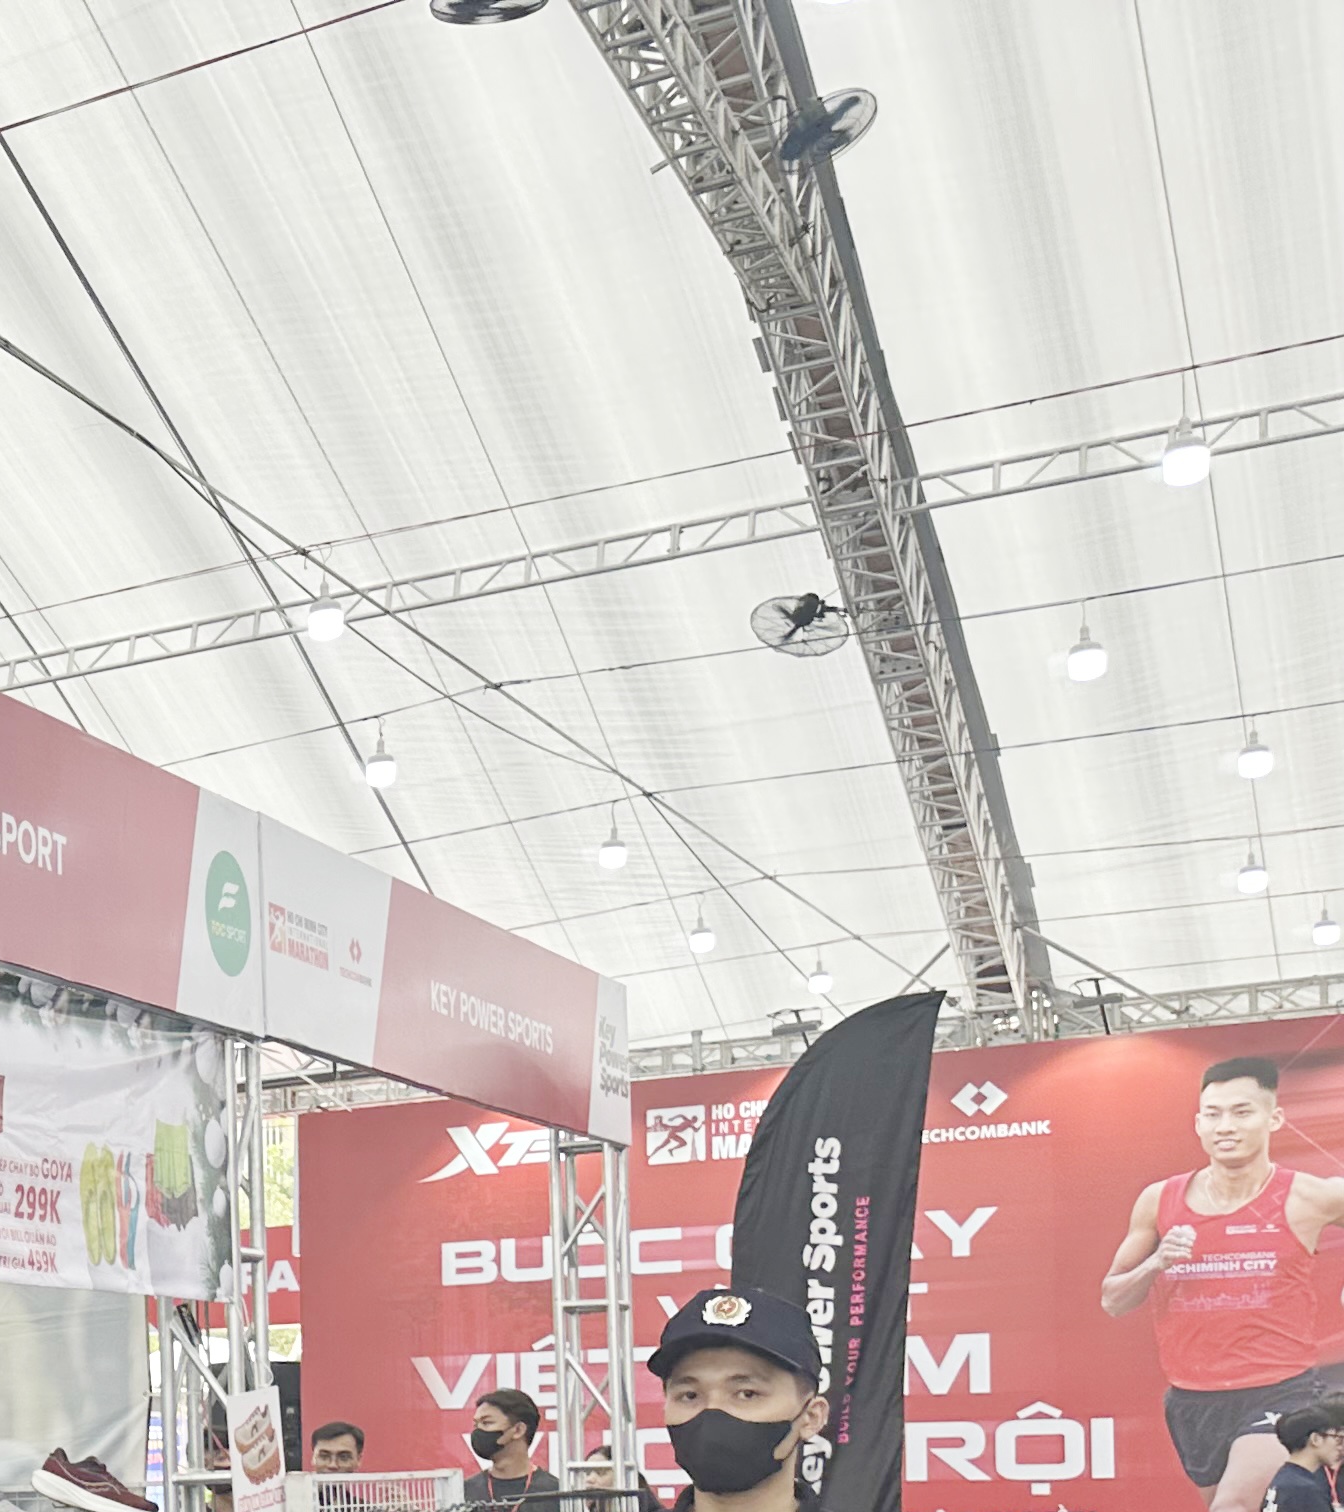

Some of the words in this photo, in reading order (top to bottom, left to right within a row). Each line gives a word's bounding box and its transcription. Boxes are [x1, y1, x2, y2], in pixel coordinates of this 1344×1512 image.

[430, 980, 457, 1018] KEY
[461, 991, 505, 1037] POWER
[508, 1011, 553, 1055] SPORTS
[712, 1103, 735, 1120] HO
[921, 1120, 1052, 1144] ECHCOMBANK
[41, 1158, 72, 1183] GOYA
[14, 1184, 61, 1224] 299K
[802, 1136, 844, 1273] Sports
[850, 1196, 871, 1326] PERFORMANCE
[1243, 1259, 1277, 1271] CITY
[845, 1337, 861, 1387] YOUR
[904, 1401, 1116, 1496] RỘI
